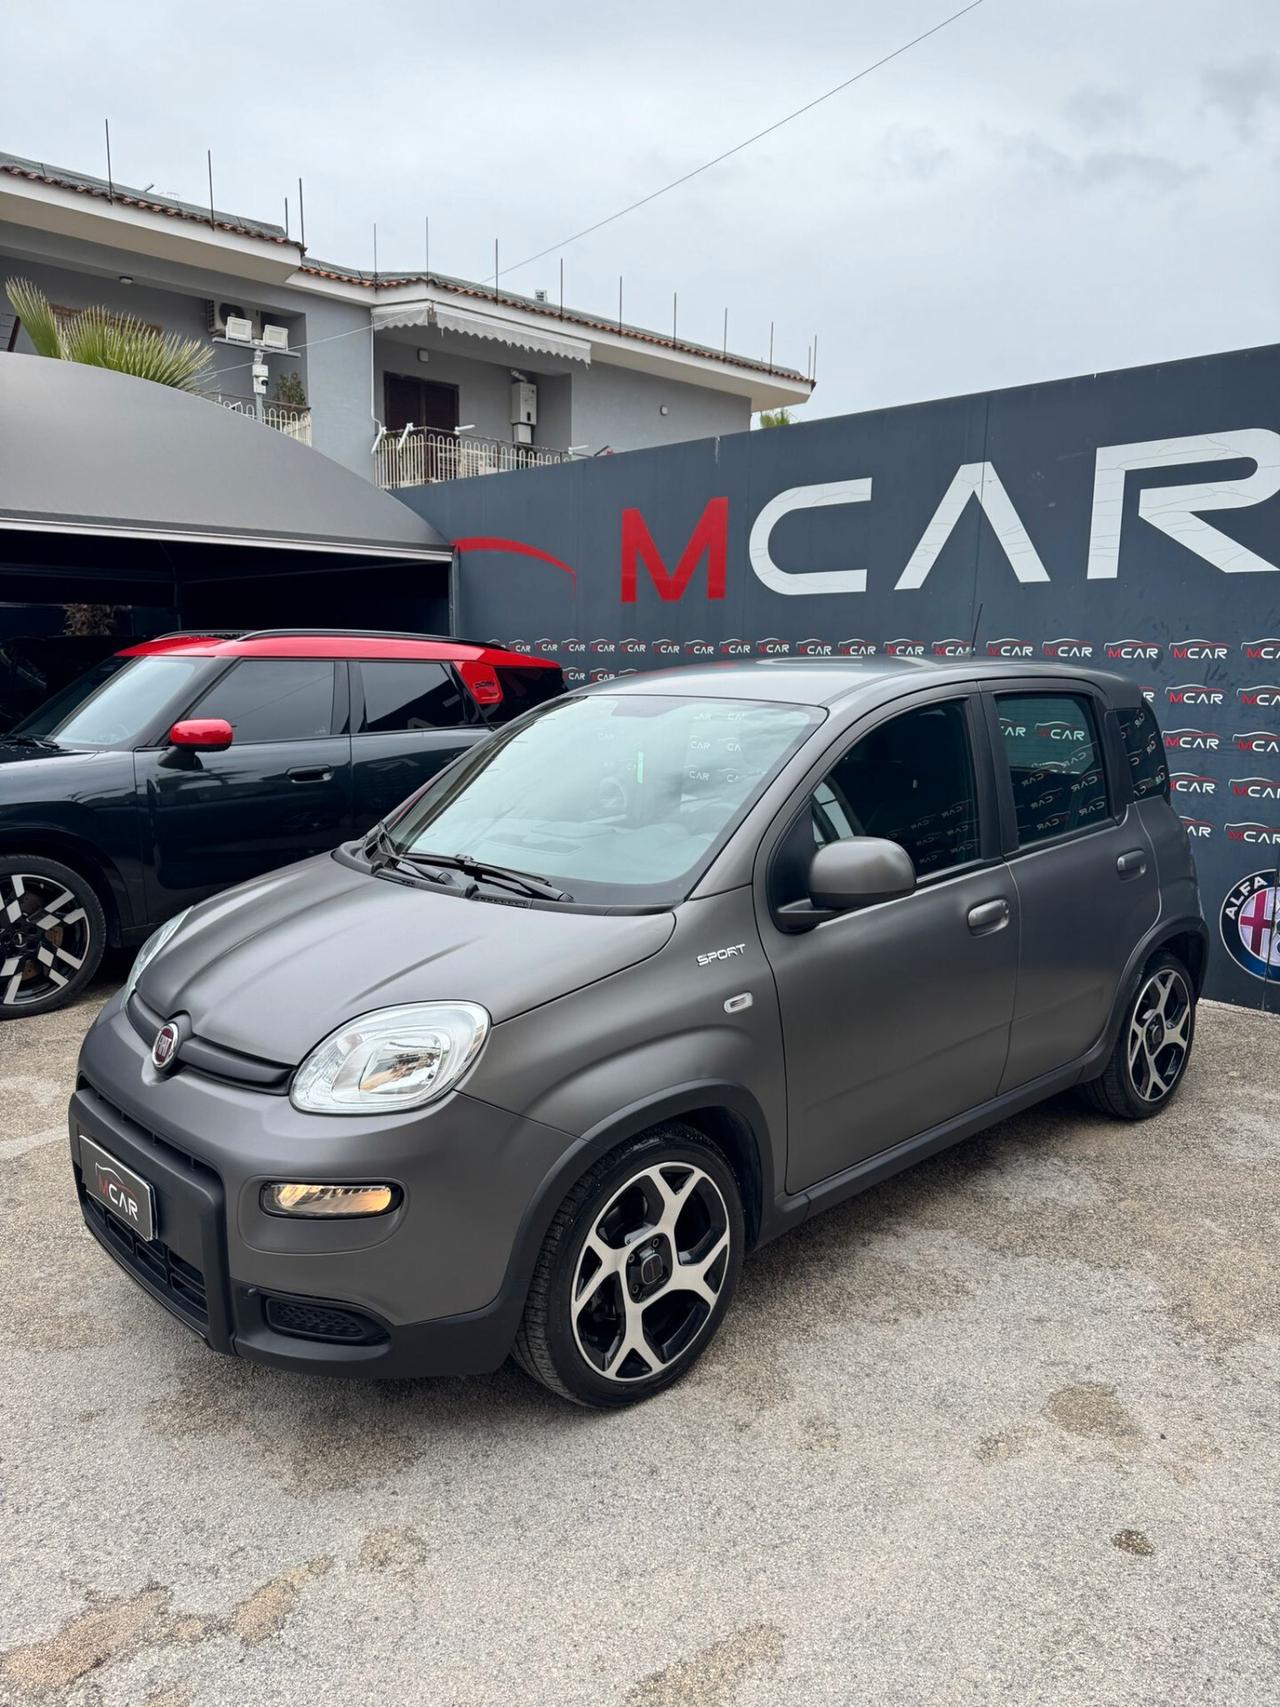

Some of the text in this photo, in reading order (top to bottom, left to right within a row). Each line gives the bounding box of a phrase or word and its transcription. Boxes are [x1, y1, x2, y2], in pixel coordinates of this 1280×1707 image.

[621, 428, 1280, 602] MCAR
[509, 644, 531, 652] CAR
[535, 643, 558, 652] CAR
[887, 646, 924, 656] MCAR
[988, 646, 1033, 657] MCAR
[1043, 646, 1092, 657] MCAR
[1107, 647, 1158, 659] MCAR
[1173, 648, 1227, 659] MCAR
[563, 672, 586, 681] CAR
[1169, 692, 1223, 704] MCAR
[1241, 693, 1280, 706] MCA
[1165, 737, 1219, 750] MCAR
[1237, 740, 1280, 752] MCA
[1233, 784, 1280, 799] MCA
[1225, 876, 1268, 920] ALFA
[697, 943, 746, 966] SPORT
[97, 1176, 138, 1221] MCAR
